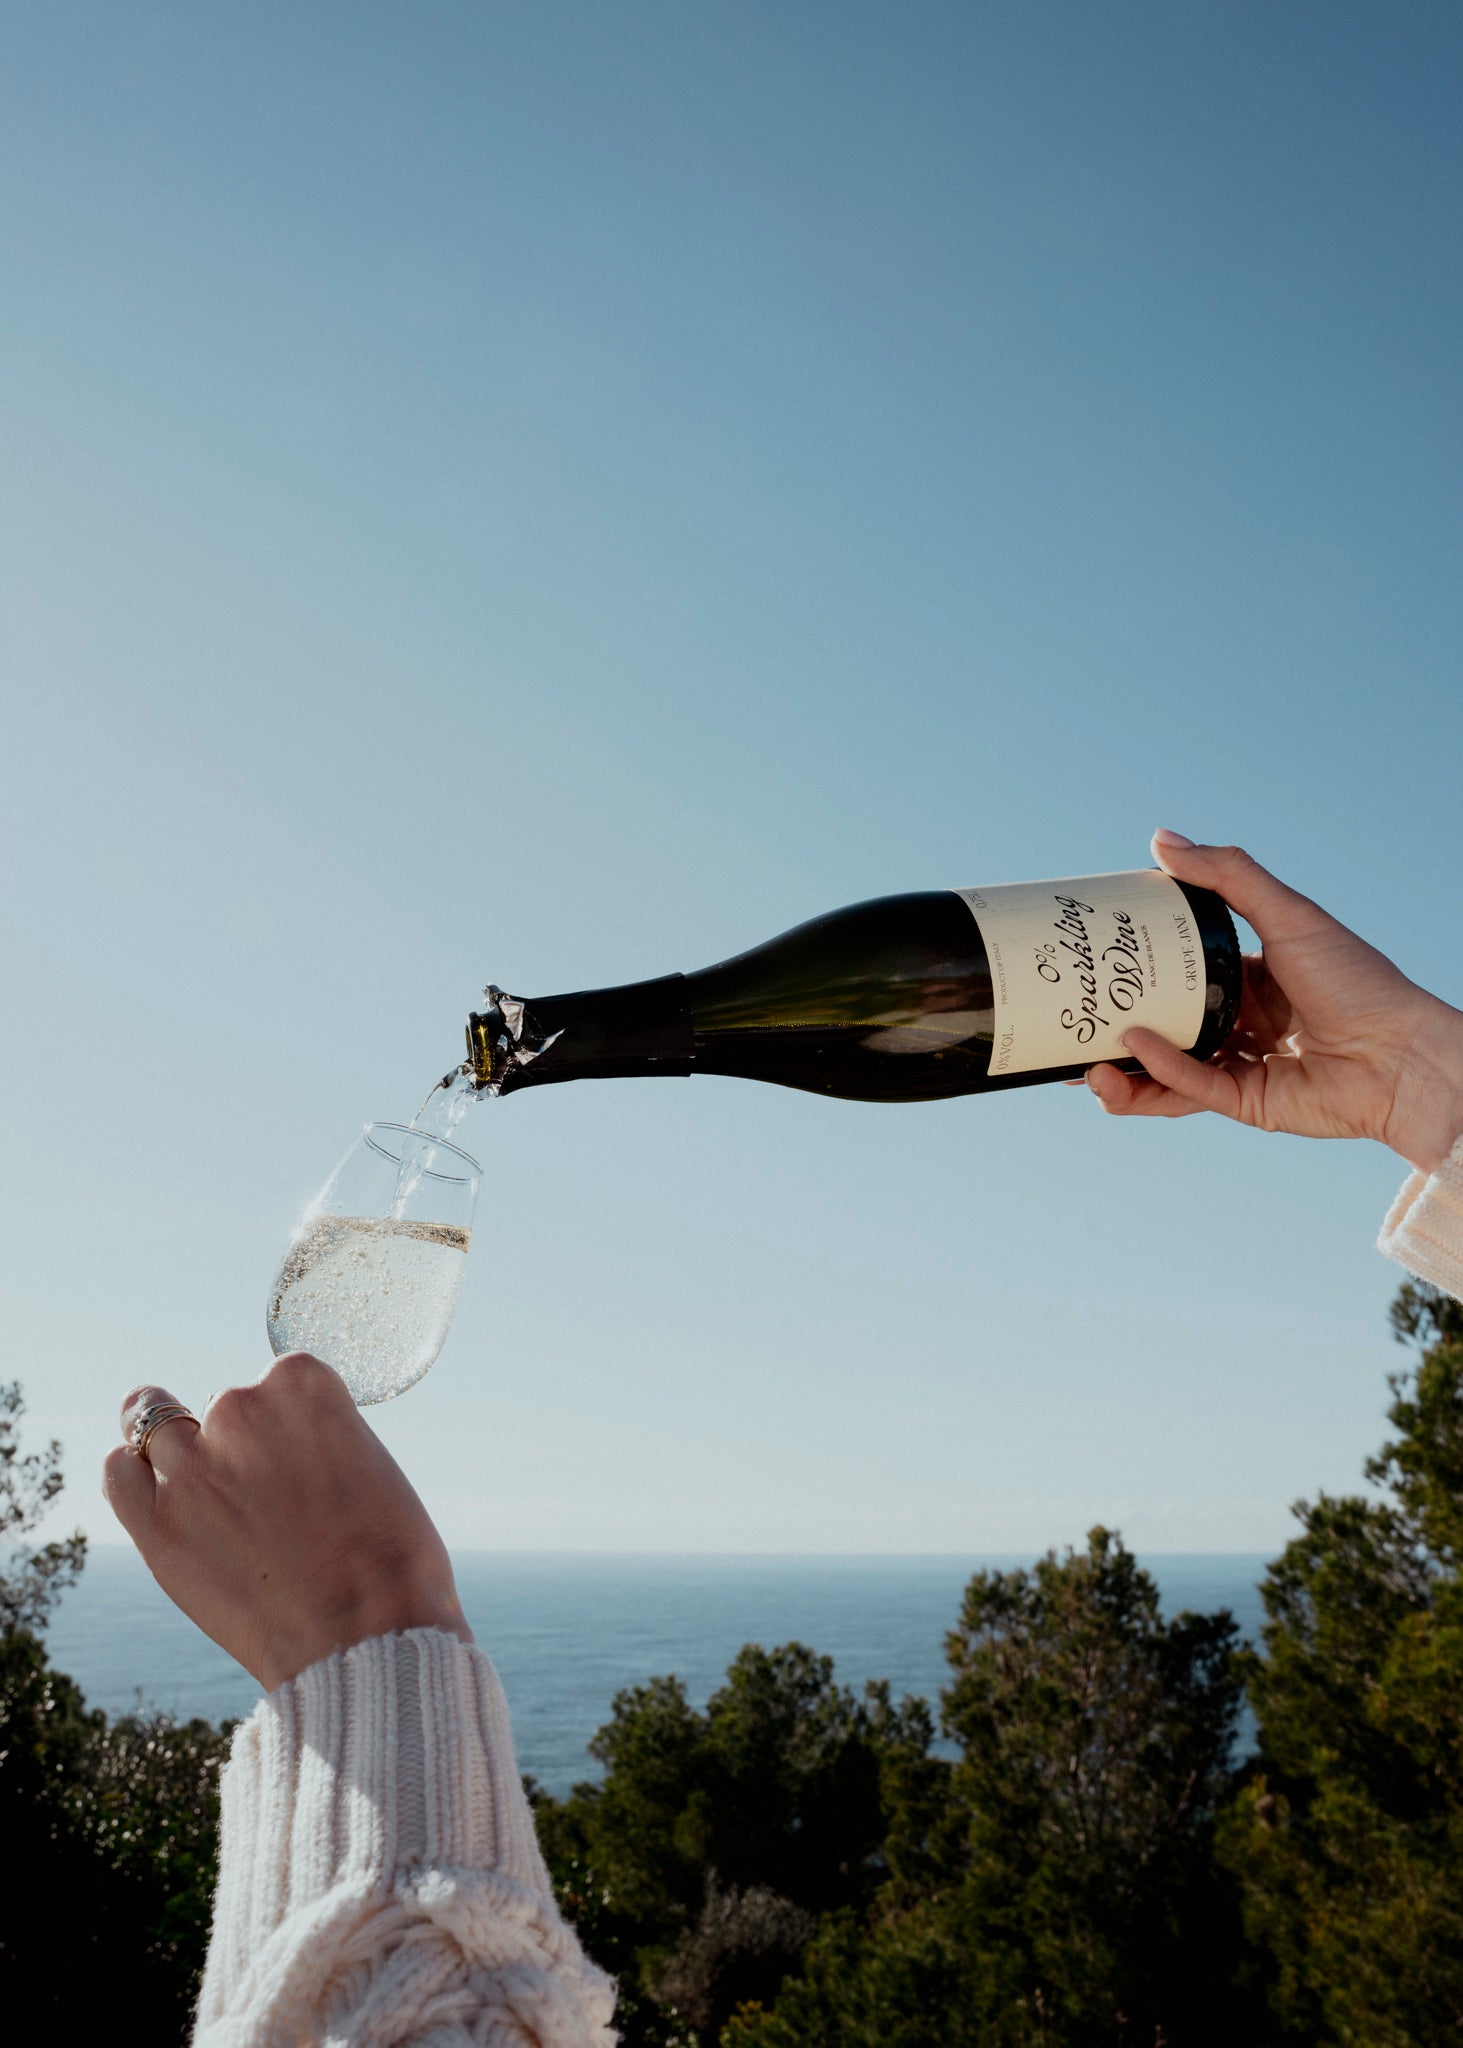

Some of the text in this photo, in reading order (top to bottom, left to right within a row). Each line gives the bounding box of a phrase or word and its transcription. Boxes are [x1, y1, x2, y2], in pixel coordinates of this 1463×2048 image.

[991, 942, 1008, 1005] PRODUCT OF ITALY
[1035, 943, 1061, 983] 0%
[1053, 894, 1110, 1044] Sparkling
[1101, 911, 1144, 1012] Wine
[1140, 925, 1157, 988] BLANC DE BLANCS
[1172, 913, 1198, 991] GRAPE JANE
